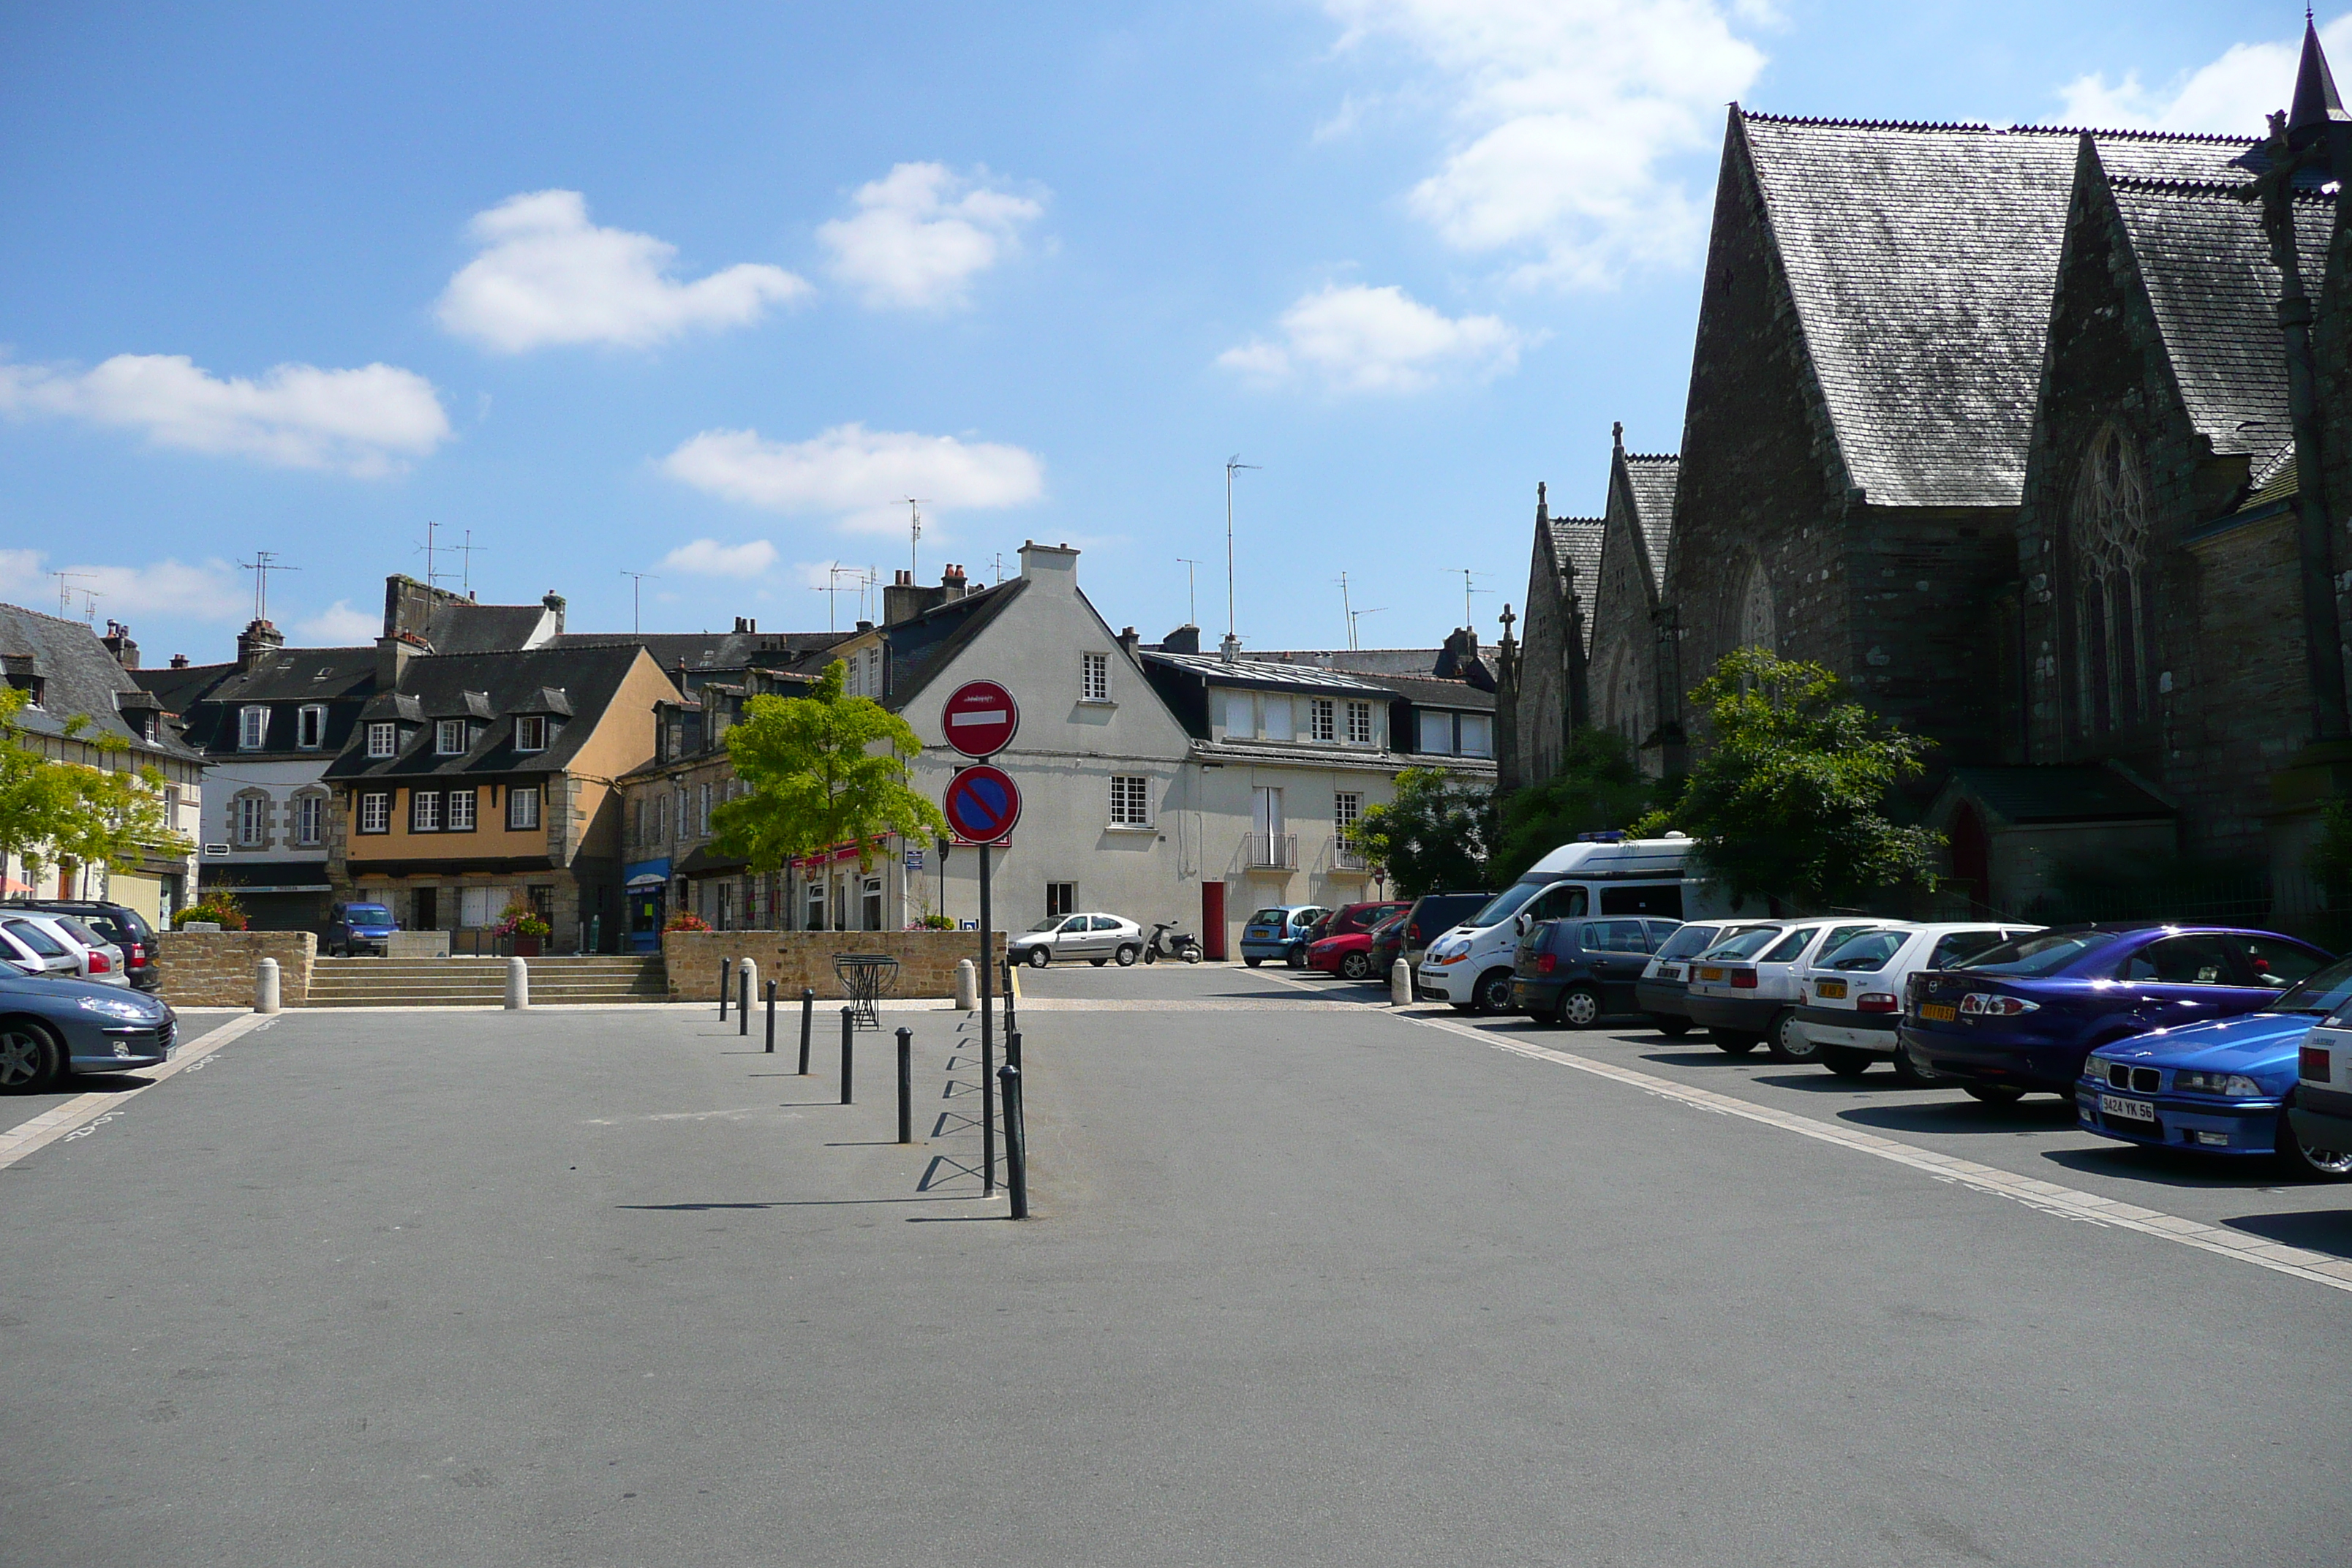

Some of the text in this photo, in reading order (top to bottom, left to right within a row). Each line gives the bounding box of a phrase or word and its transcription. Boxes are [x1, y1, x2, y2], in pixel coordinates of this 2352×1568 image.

[2103, 1098, 2152, 1118] 9424 YK 56
